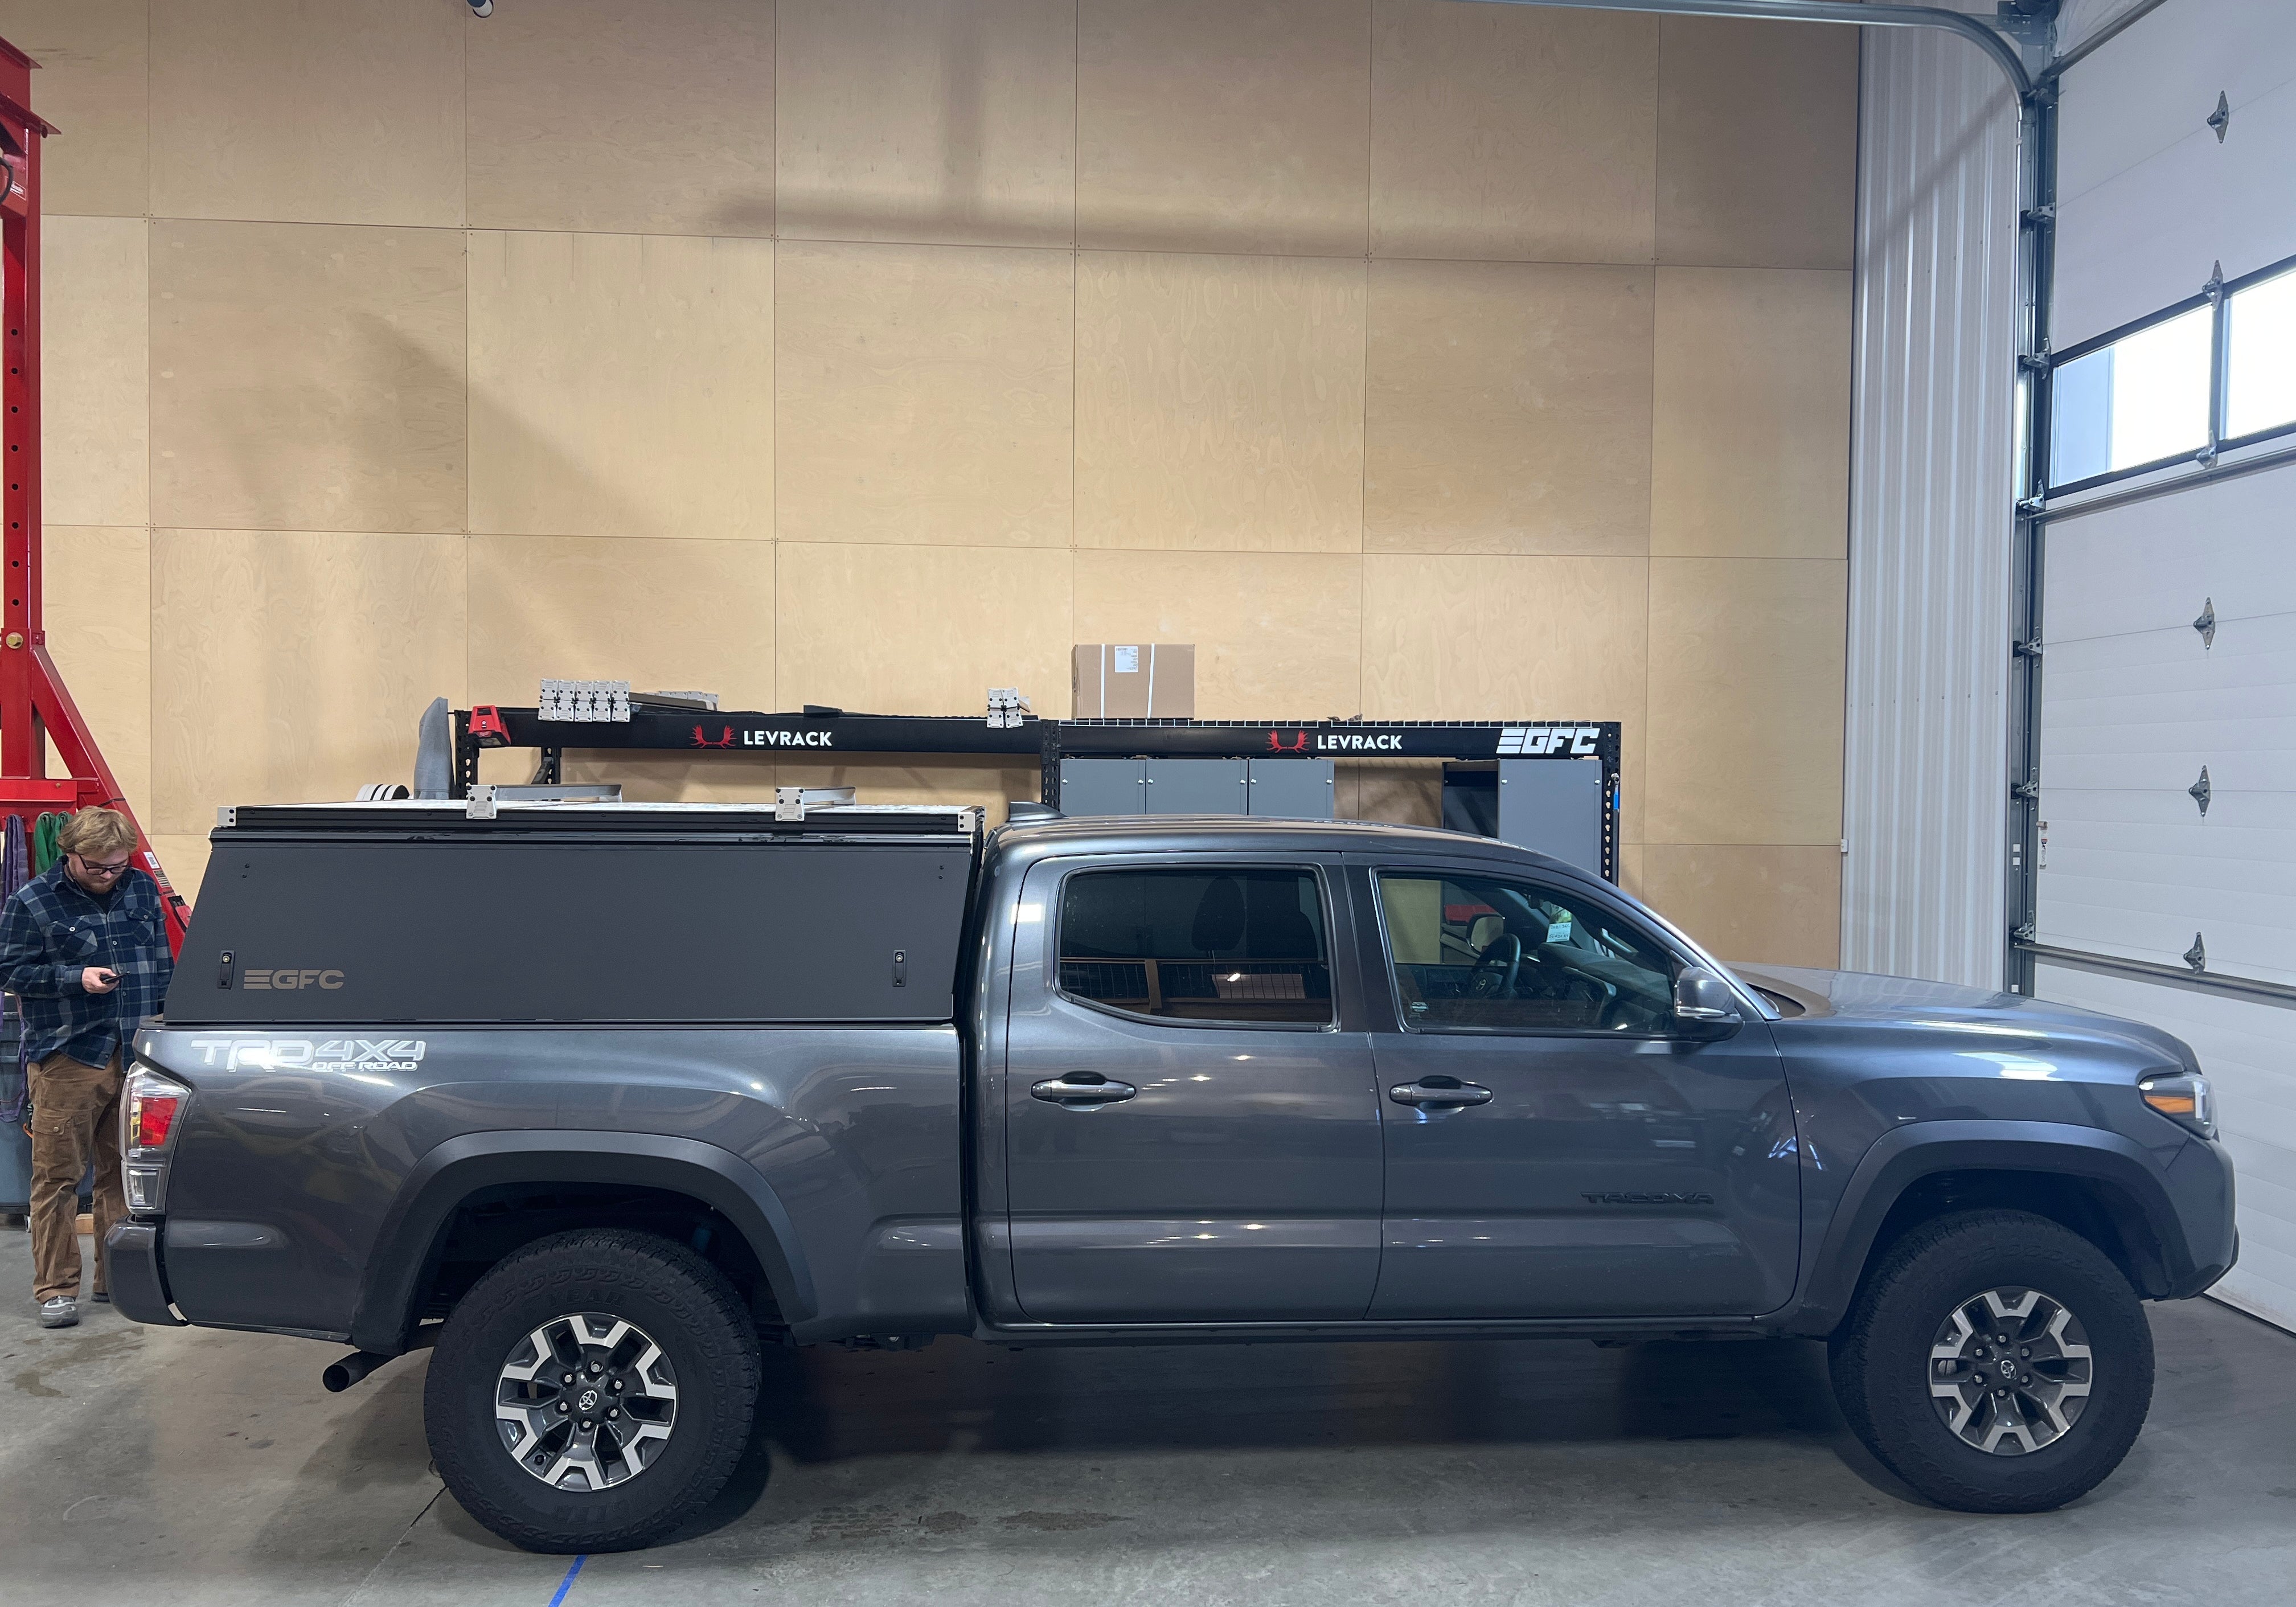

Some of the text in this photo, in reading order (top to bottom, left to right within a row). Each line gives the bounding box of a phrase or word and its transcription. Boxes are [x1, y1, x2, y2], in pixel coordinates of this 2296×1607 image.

[744, 730, 832, 746] LEVRACK
[1317, 734, 1403, 749] LEVRACK
[191, 1039, 315, 1073] TRD
[312, 1061, 418, 1072] OFF ROAD
[1580, 1191, 1715, 1205] TACOMA
